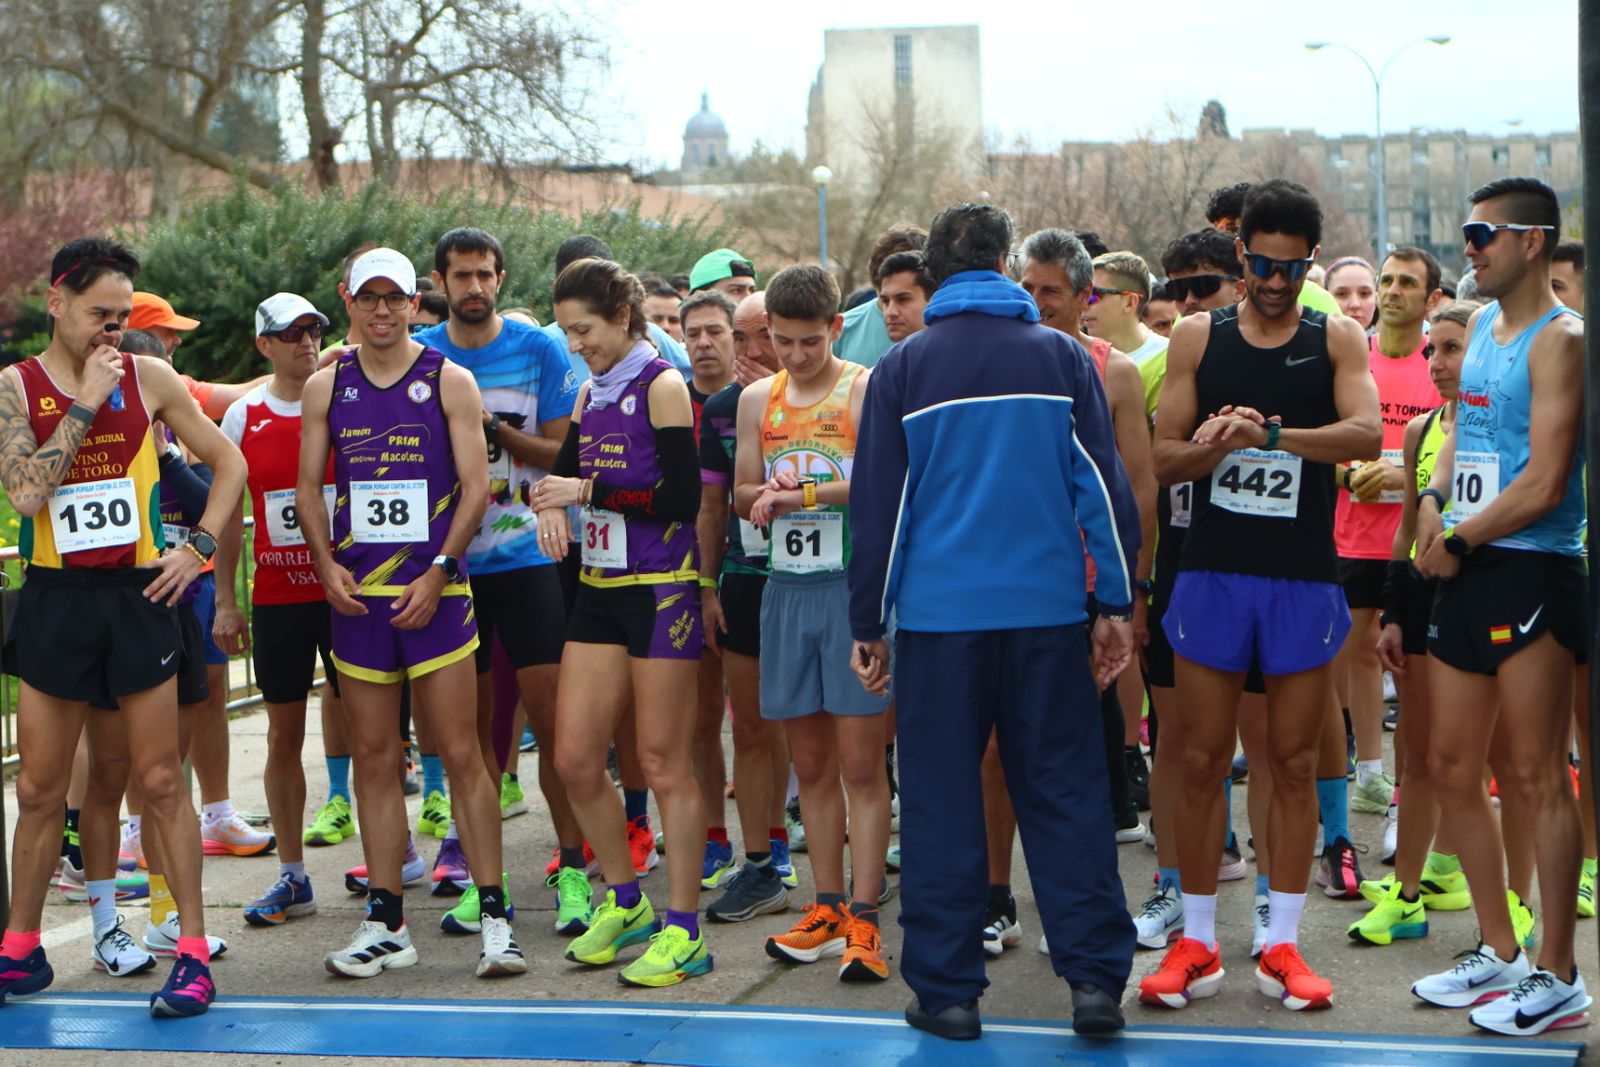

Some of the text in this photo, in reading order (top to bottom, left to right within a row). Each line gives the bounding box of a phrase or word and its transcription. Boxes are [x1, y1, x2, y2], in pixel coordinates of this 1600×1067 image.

[80, 433, 126, 447] JA RURAL
[388, 435, 420, 447] PRIM
[600, 443, 624, 455] PRIM
[74, 451, 109, 465] VINO
[380, 451, 424, 463] Macotera
[82, 463, 123, 478] TORO
[1218, 464, 1293, 500] 442
[1456, 472, 1483, 503] 10
[1177, 484, 1190, 511] 1
[59, 498, 132, 534] 130
[367, 499, 410, 527] 38
[586, 521, 610, 550] 31
[785, 529, 821, 557] 61
[260, 550, 315, 566] CORREL
